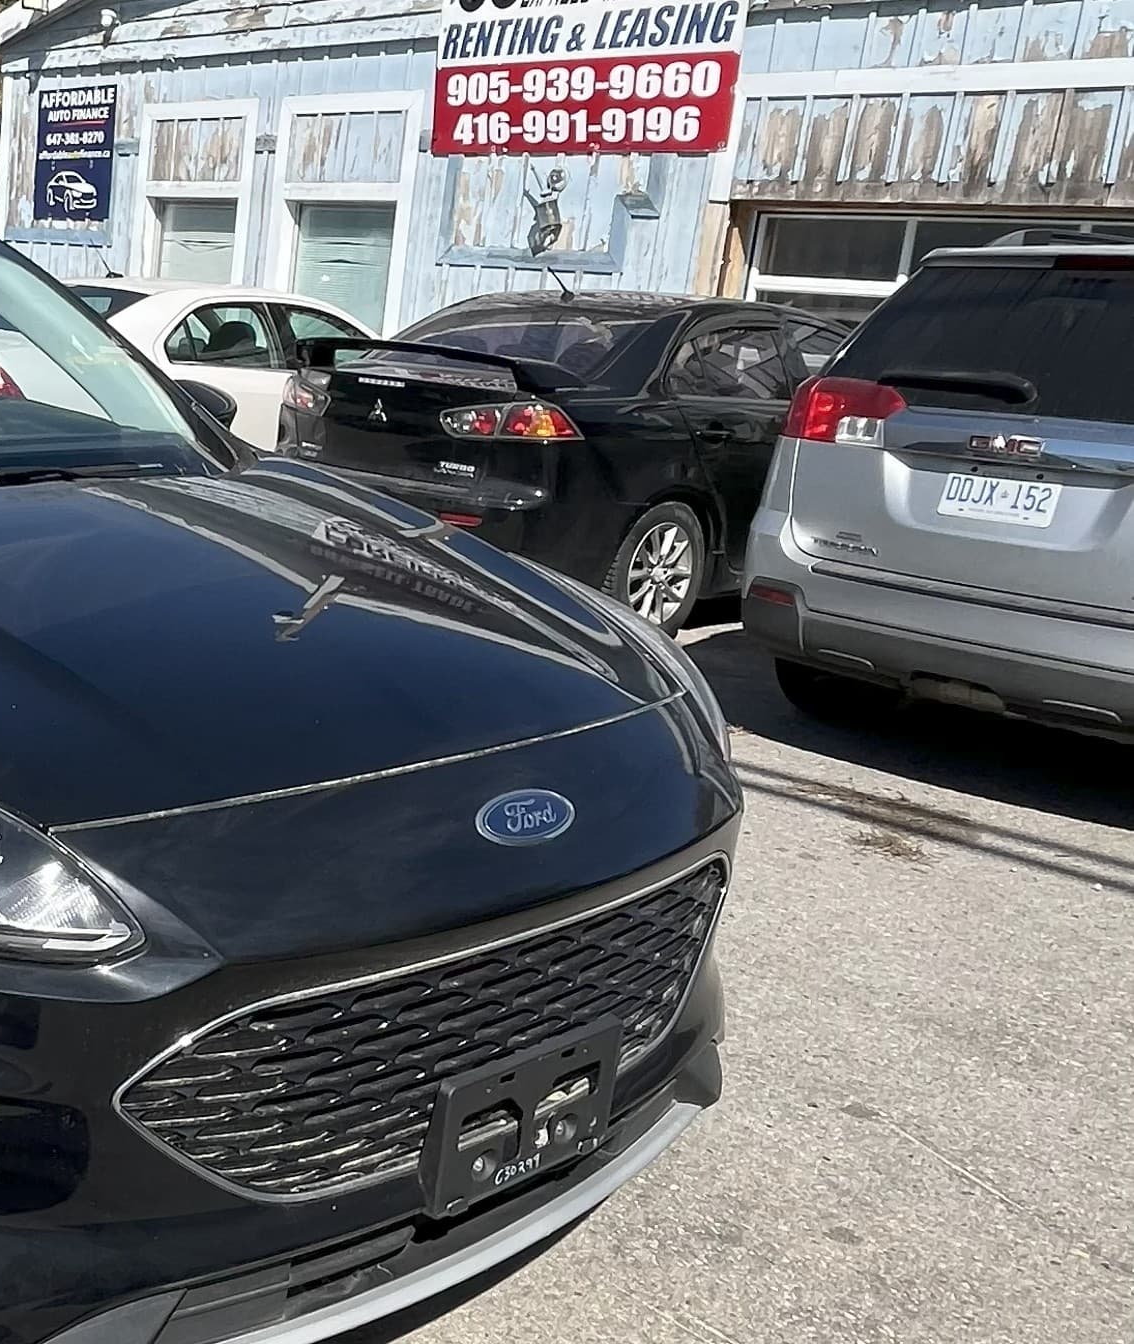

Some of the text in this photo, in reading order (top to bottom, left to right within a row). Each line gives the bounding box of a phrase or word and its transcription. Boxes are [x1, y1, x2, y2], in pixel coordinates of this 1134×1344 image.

[441, 0, 741, 60] RENTING & LEASING
[41, 87, 115, 109] AFFORDABLE
[446, 59, 722, 107] 905-939-9660
[47, 106, 110, 123] AUTO FINANCE
[452, 105, 702, 145] 416-991-9196
[1010, 484, 1053, 513] 152
[504, 798, 557, 833] Ford
